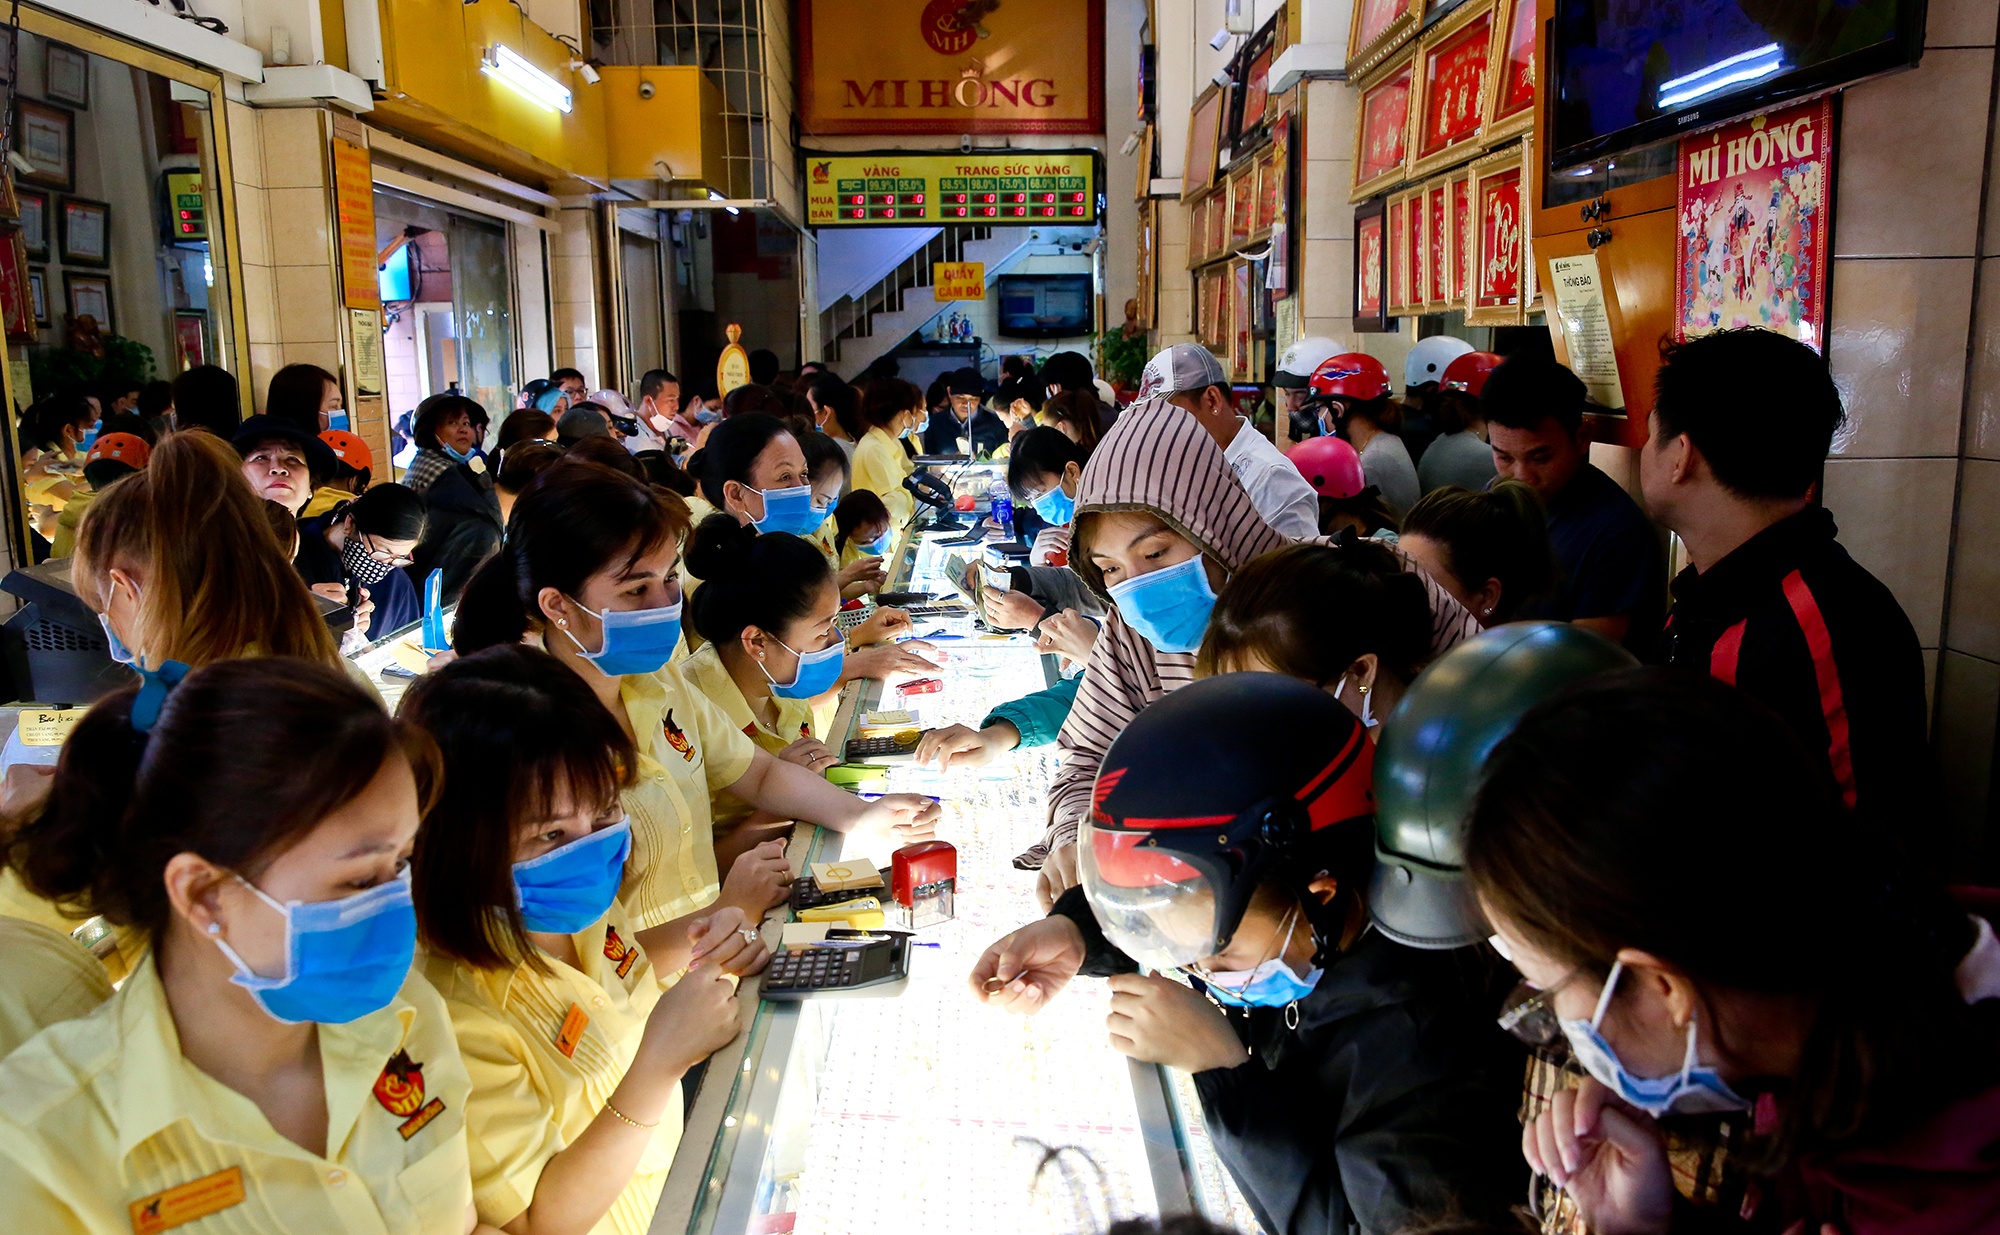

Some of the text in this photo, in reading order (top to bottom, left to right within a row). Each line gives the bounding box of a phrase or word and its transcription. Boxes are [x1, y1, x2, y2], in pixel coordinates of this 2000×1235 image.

[842, 79, 909, 108] MI
[1678, 111, 1700, 125] SAMSUNG
[863, 164, 900, 177] VÀNG
[955, 165, 1000, 176] TRANG
[1034, 162, 1071, 175] VÀNG
[869, 180, 894, 191] 99.9%
[898, 180, 924, 191] 95.0%
[1000, 177, 1025, 189] 75.0%
[1059, 178, 1084, 189] 61.0%
[811, 196, 835, 205] MUA
[811, 207, 833, 218] BÁN
